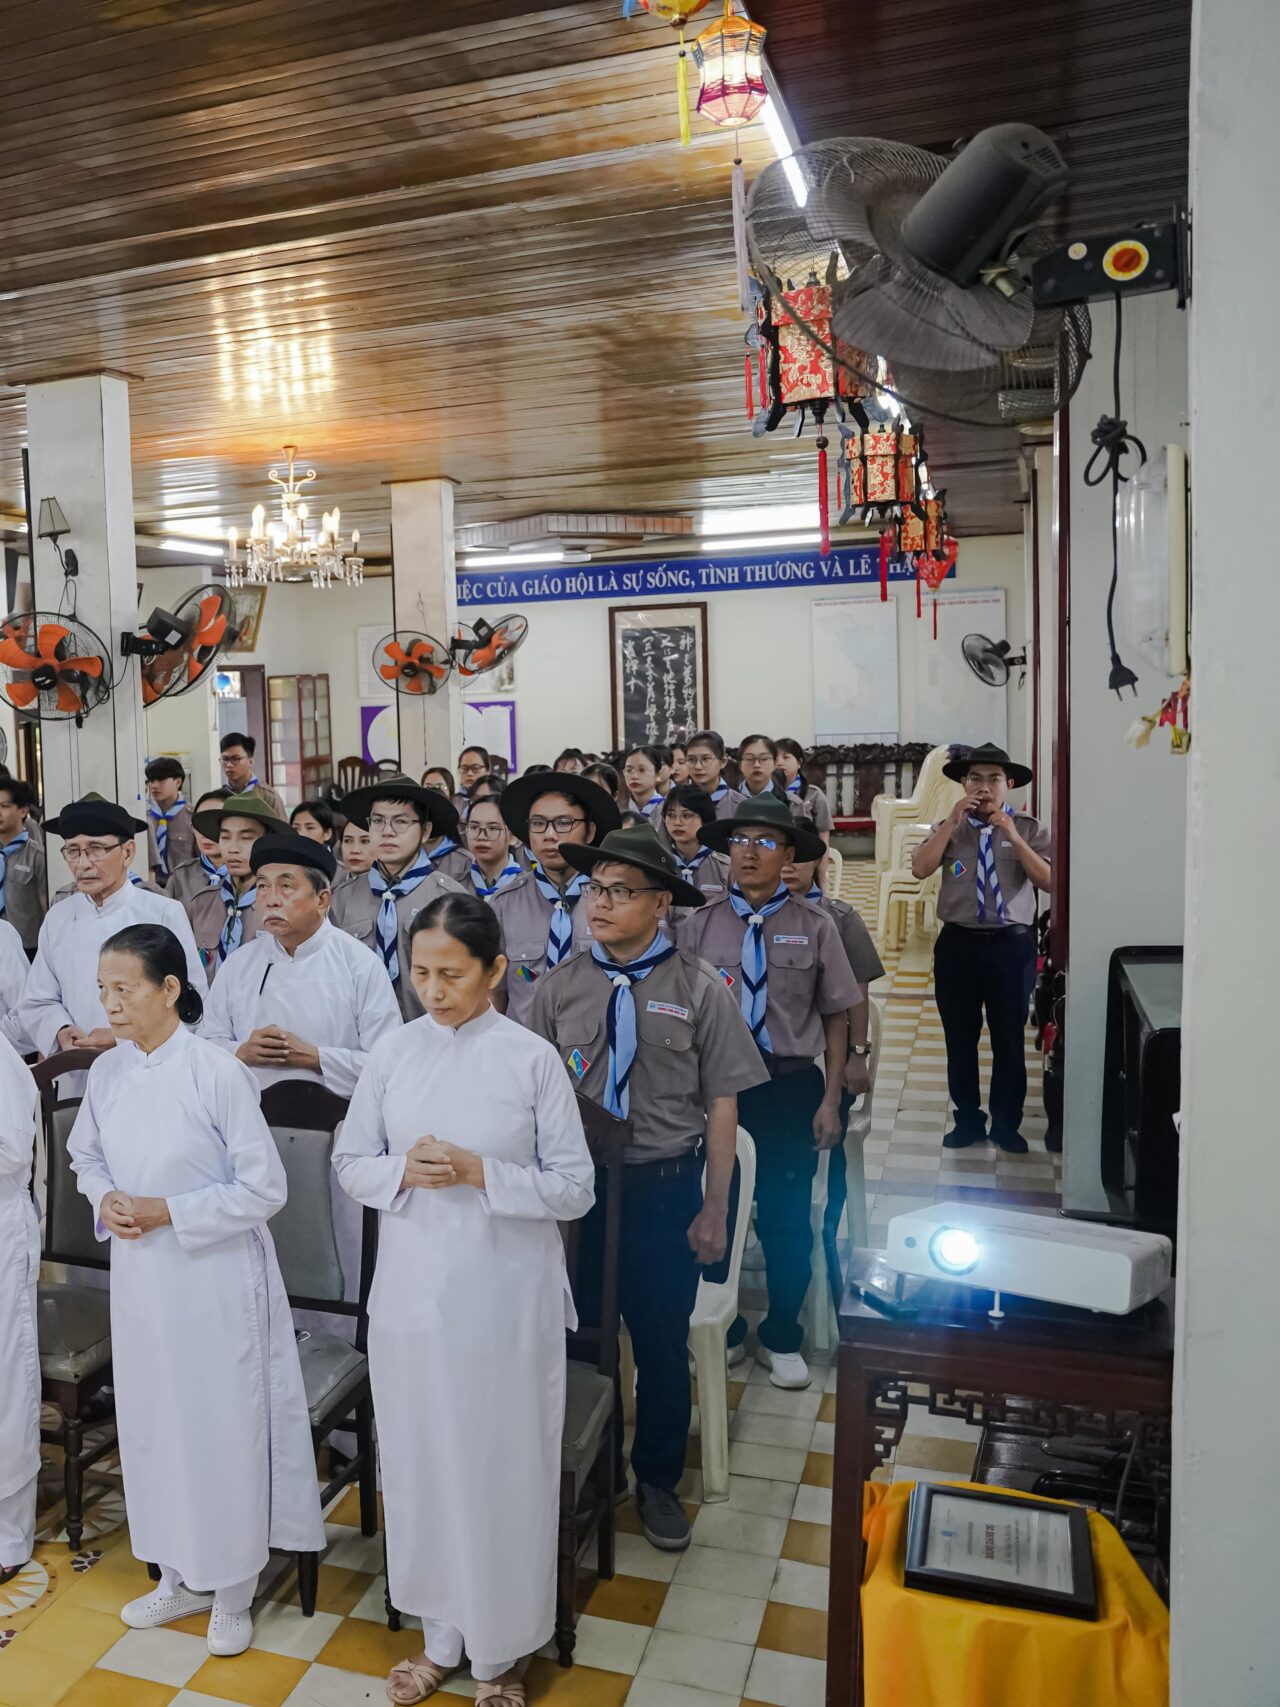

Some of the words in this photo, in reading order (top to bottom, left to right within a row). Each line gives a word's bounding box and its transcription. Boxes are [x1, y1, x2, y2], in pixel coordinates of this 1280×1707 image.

[456, 578, 483, 602] IỆC
[486, 576, 519, 598] CỦA
[521, 574, 562, 596] GIÁO
[564, 571, 594, 595] HỘI
[597, 569, 619, 591] LÀ
[622, 569, 644, 592] SỰ
[646, 563, 696, 588] SỐNG,
[698, 563, 740, 585] TÌNH
[743, 560, 815, 582] THƯƠNG
[820, 555, 844, 577] VÀ
[848, 554, 872, 576] LẼ
